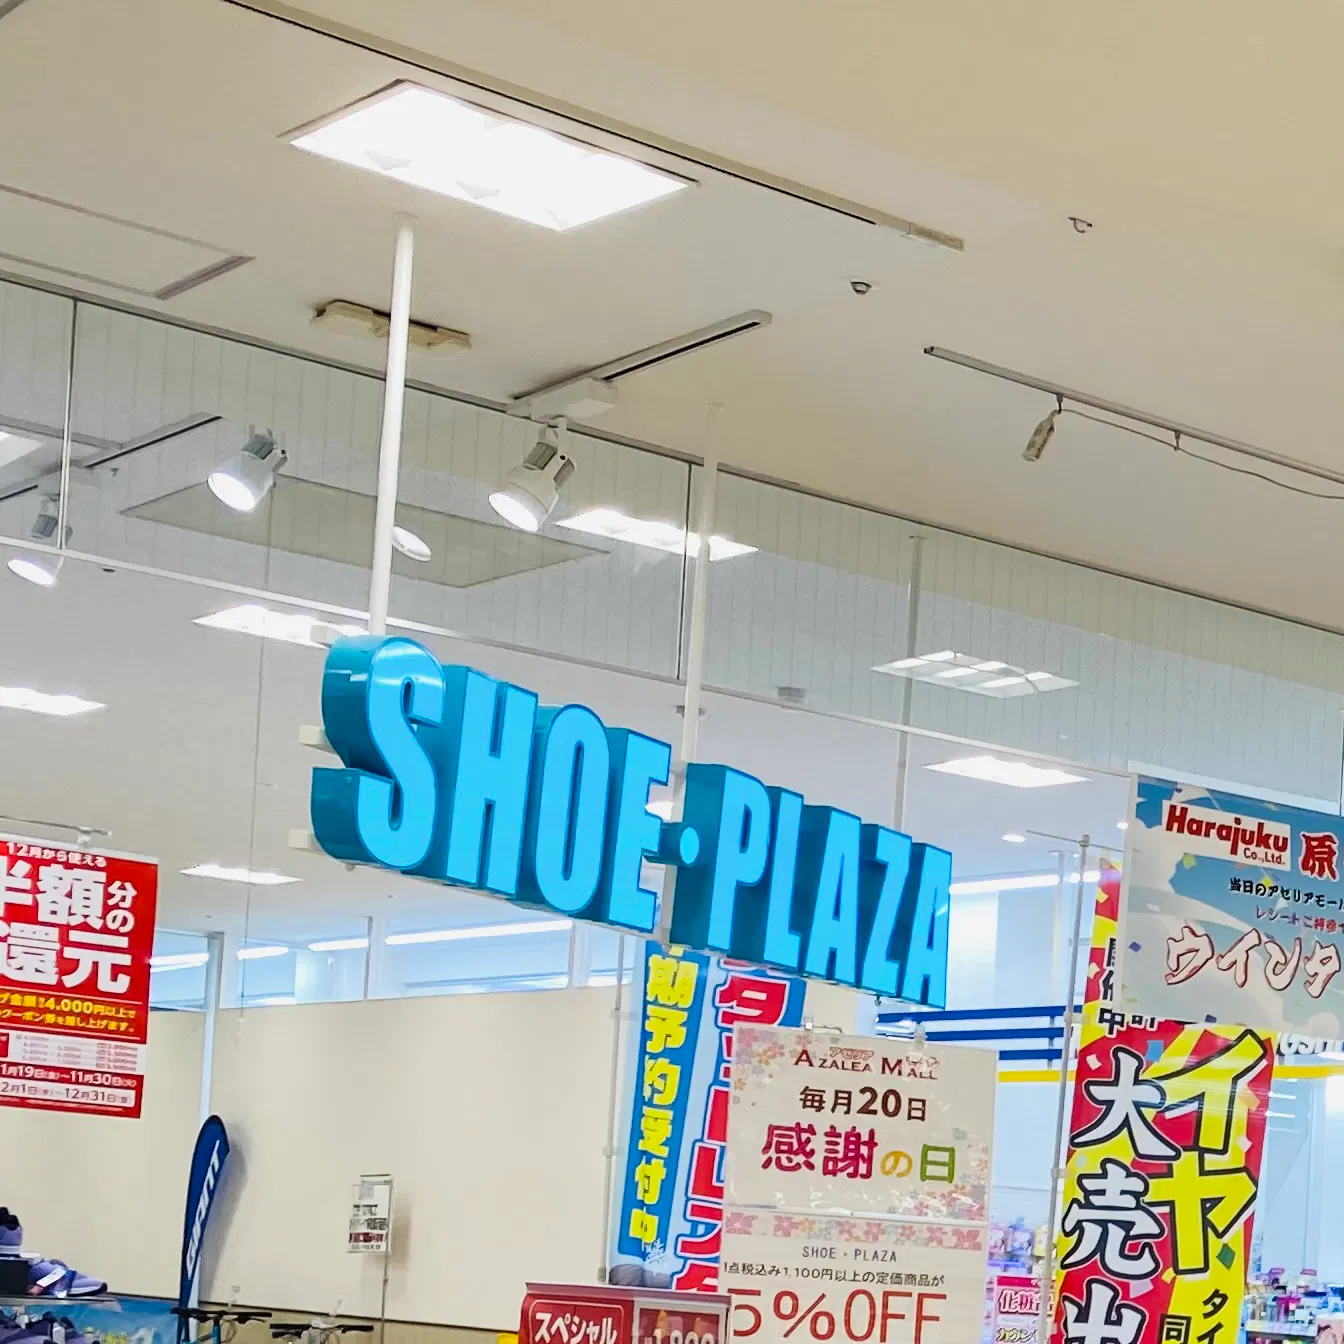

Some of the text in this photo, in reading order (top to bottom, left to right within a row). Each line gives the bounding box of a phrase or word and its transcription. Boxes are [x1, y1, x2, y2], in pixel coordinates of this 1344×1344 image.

[1165, 804, 1289, 855] Harajuku
[794, 1049, 938, 1081] AZALEA MALL
[629, 945, 699, 1243] 期予約受付中
[800, 1086, 927, 1122] 毎月20日
[761, 1122, 956, 1184] 感謝の日
